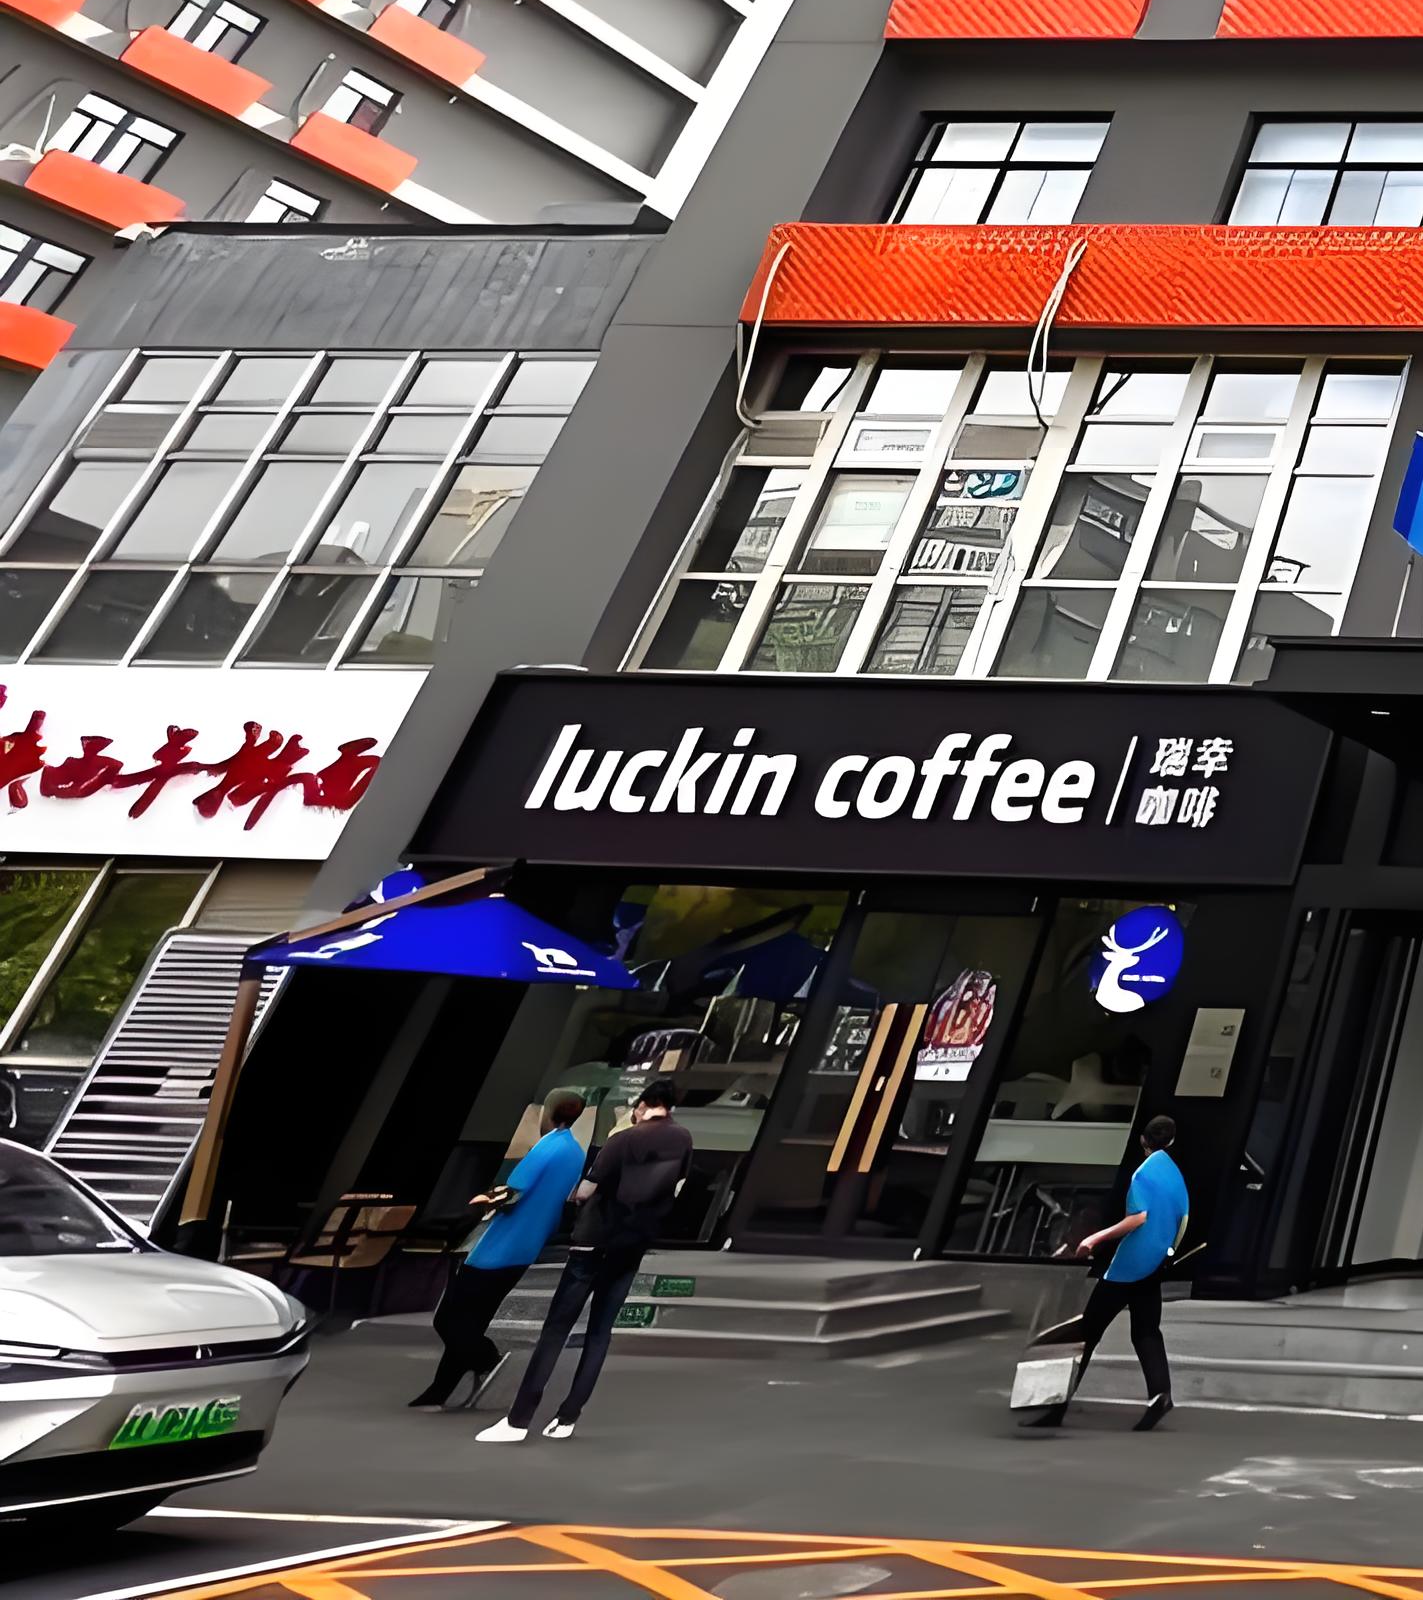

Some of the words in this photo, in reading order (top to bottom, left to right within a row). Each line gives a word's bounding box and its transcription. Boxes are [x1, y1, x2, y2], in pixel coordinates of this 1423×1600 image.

[523, 723, 798, 816] luckin
[813, 732, 1096, 824] coffee
[1149, 736, 1234, 779] 瑞幸
[1135, 785, 1221, 828] 咖啡
